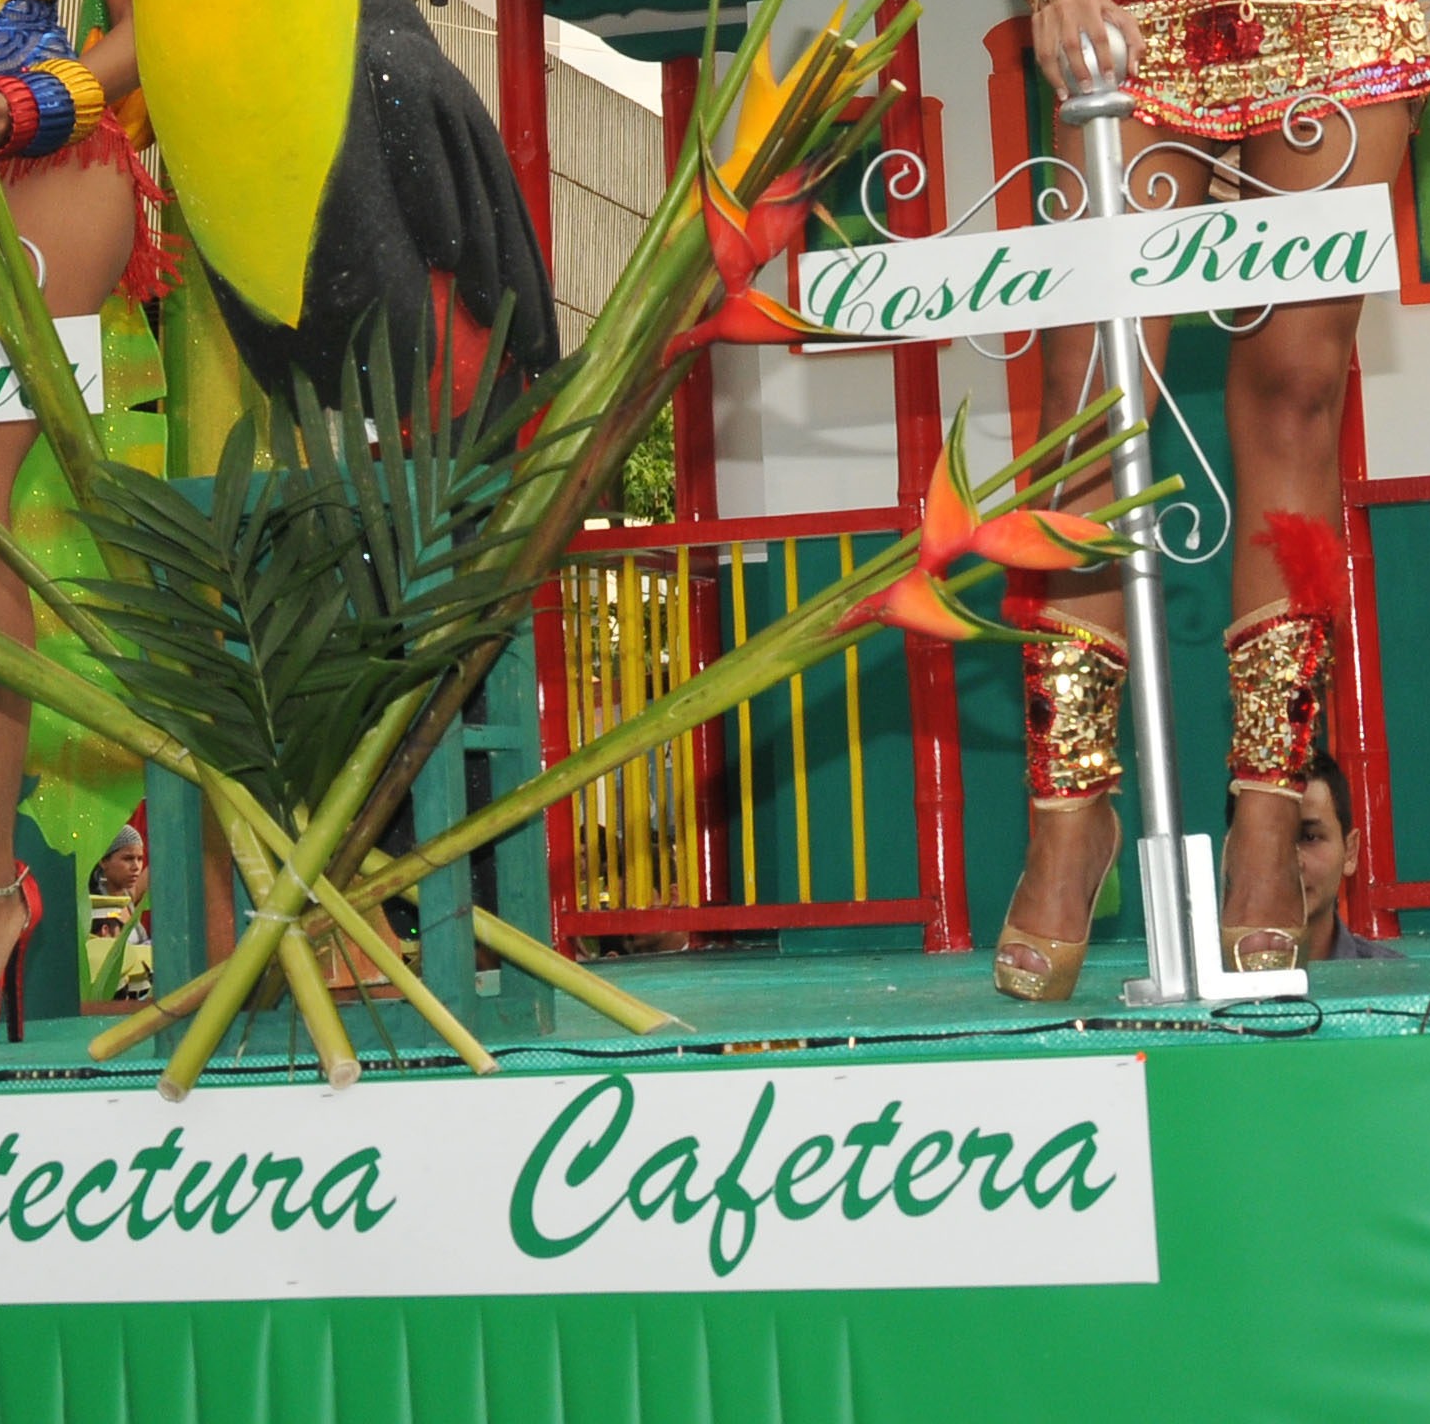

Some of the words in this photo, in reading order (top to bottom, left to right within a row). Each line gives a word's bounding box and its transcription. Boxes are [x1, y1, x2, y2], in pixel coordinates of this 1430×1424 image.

[808, 250, 1075, 335] Costa
[1130, 208, 1393, 287] Rica
[508, 1073, 1118, 1278] Cafetera
